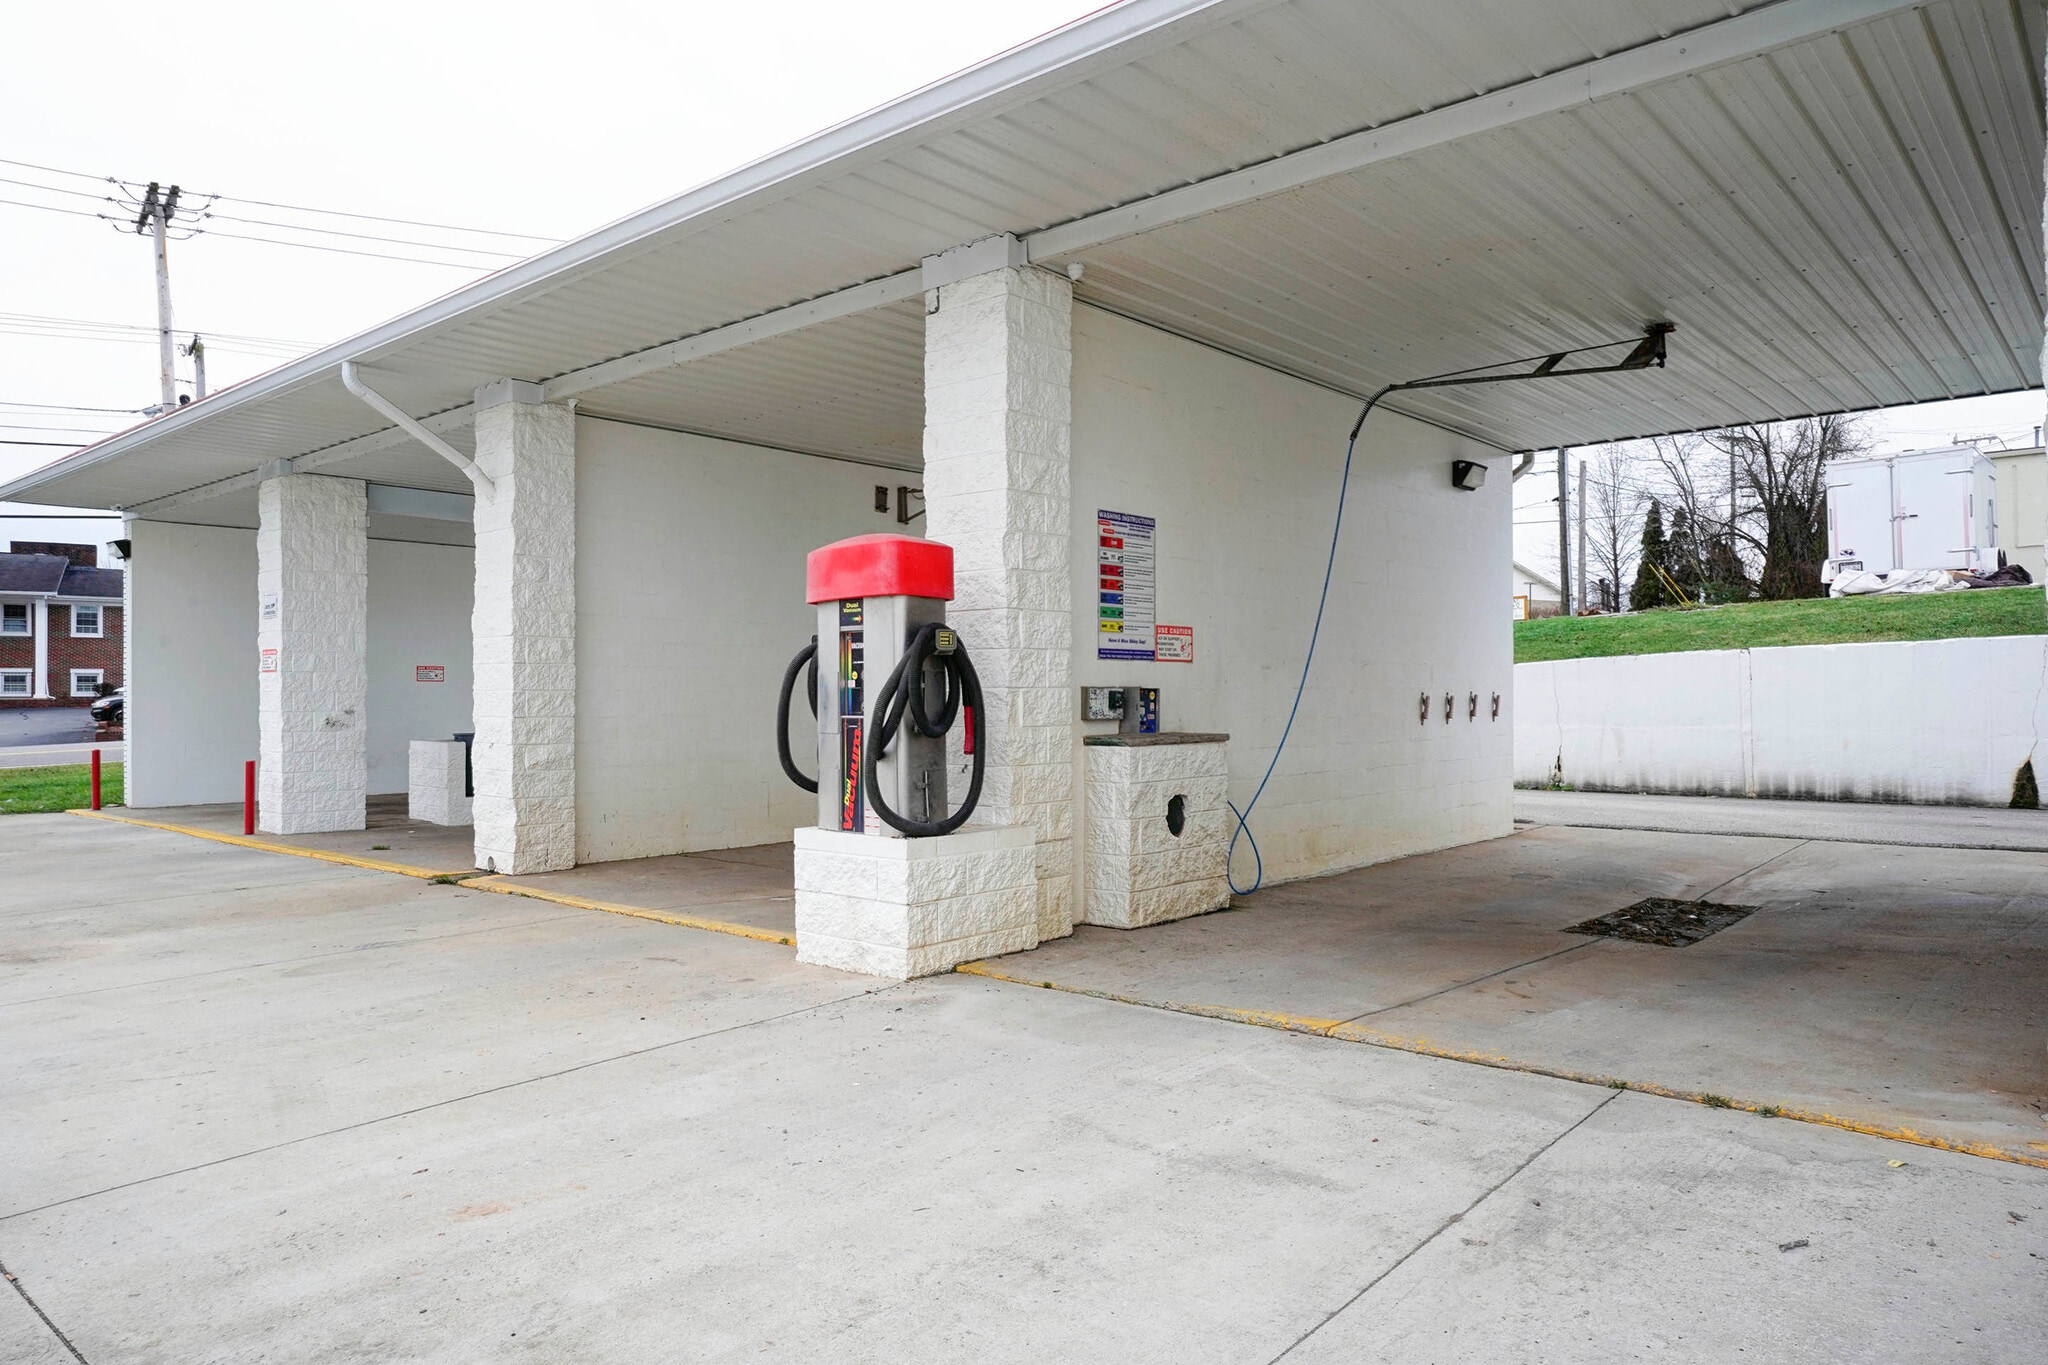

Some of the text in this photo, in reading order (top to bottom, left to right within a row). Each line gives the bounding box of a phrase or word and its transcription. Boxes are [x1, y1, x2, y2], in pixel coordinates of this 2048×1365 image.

[1099, 511, 1121, 521] WASHING
[1121, 514, 1155, 526] INSTRUCTIONS
[1169, 627, 1192, 635] CAUTION
[842, 727, 862, 829] Vacuum
[844, 778, 852, 806] Dual
